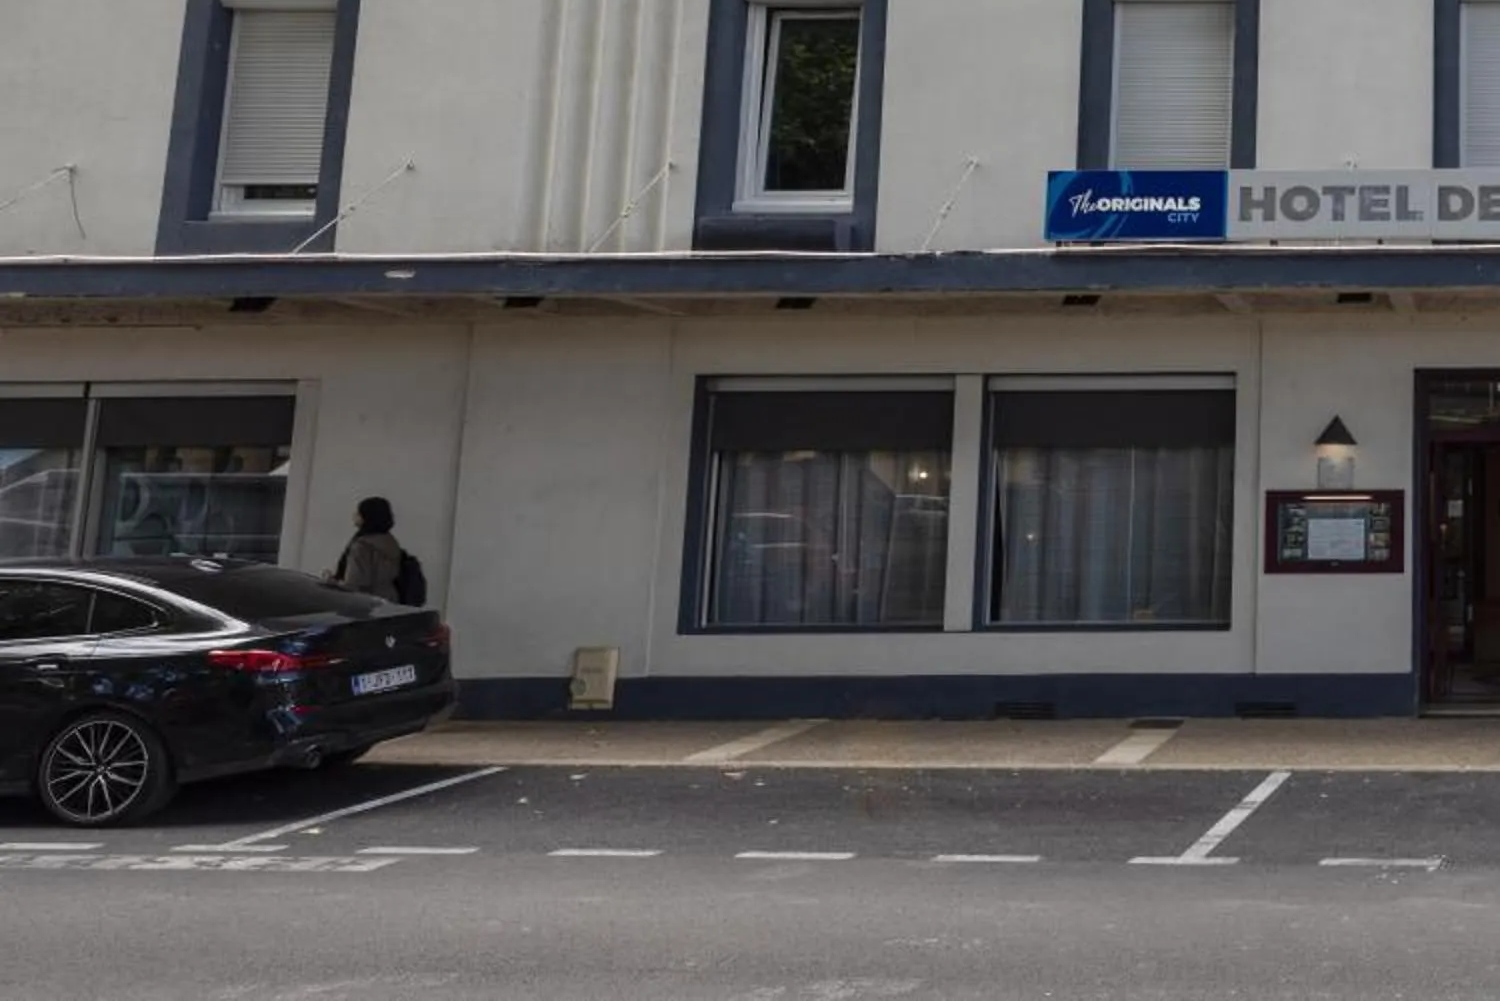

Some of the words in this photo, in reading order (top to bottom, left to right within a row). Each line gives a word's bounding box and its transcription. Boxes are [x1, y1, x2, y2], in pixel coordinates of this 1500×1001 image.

[1097, 197, 1201, 212] ORIGINALS
[1238, 185, 1424, 221] HOTEL
[1167, 213, 1200, 223] CITY
